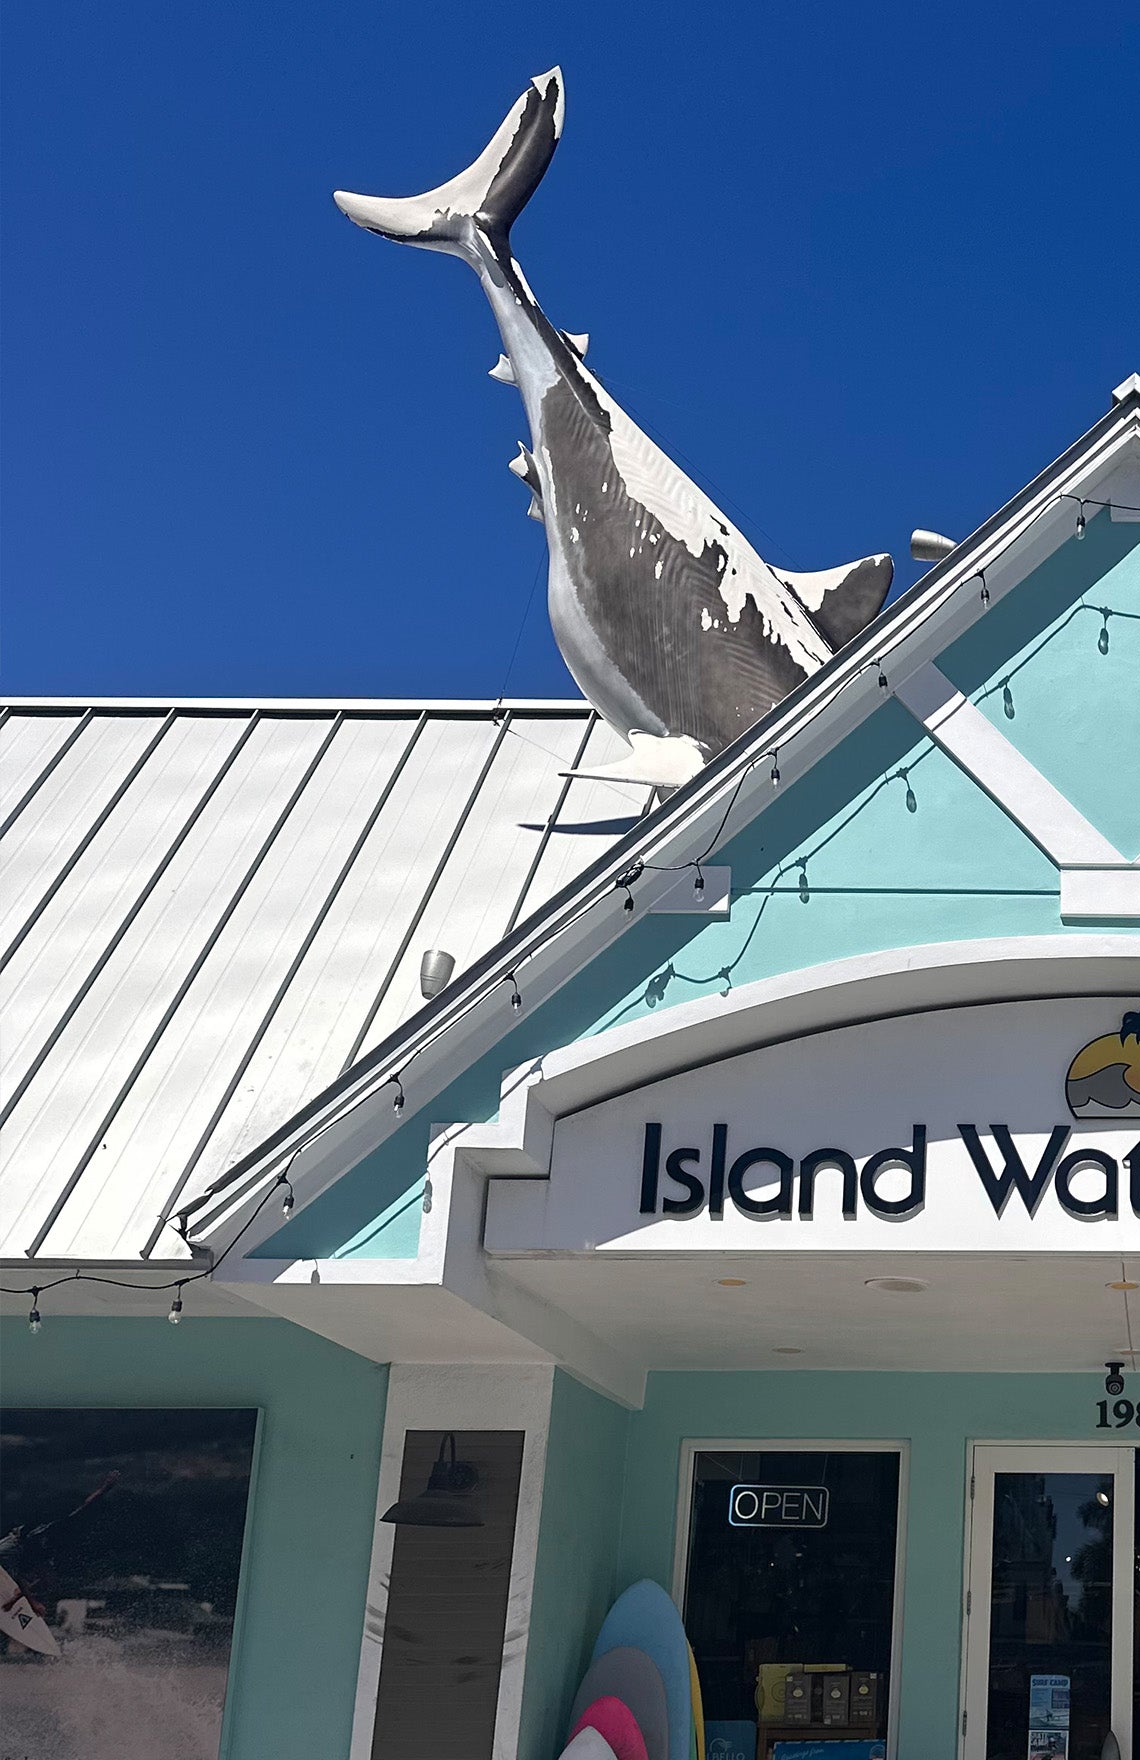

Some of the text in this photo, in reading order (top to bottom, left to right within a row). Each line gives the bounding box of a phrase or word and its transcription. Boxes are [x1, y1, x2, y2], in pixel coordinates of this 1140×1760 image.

[638, 1122, 927, 1219] Island
[735, 1491, 823, 1520] OPEN
[1050, 1679, 1068, 1687] CAMP
